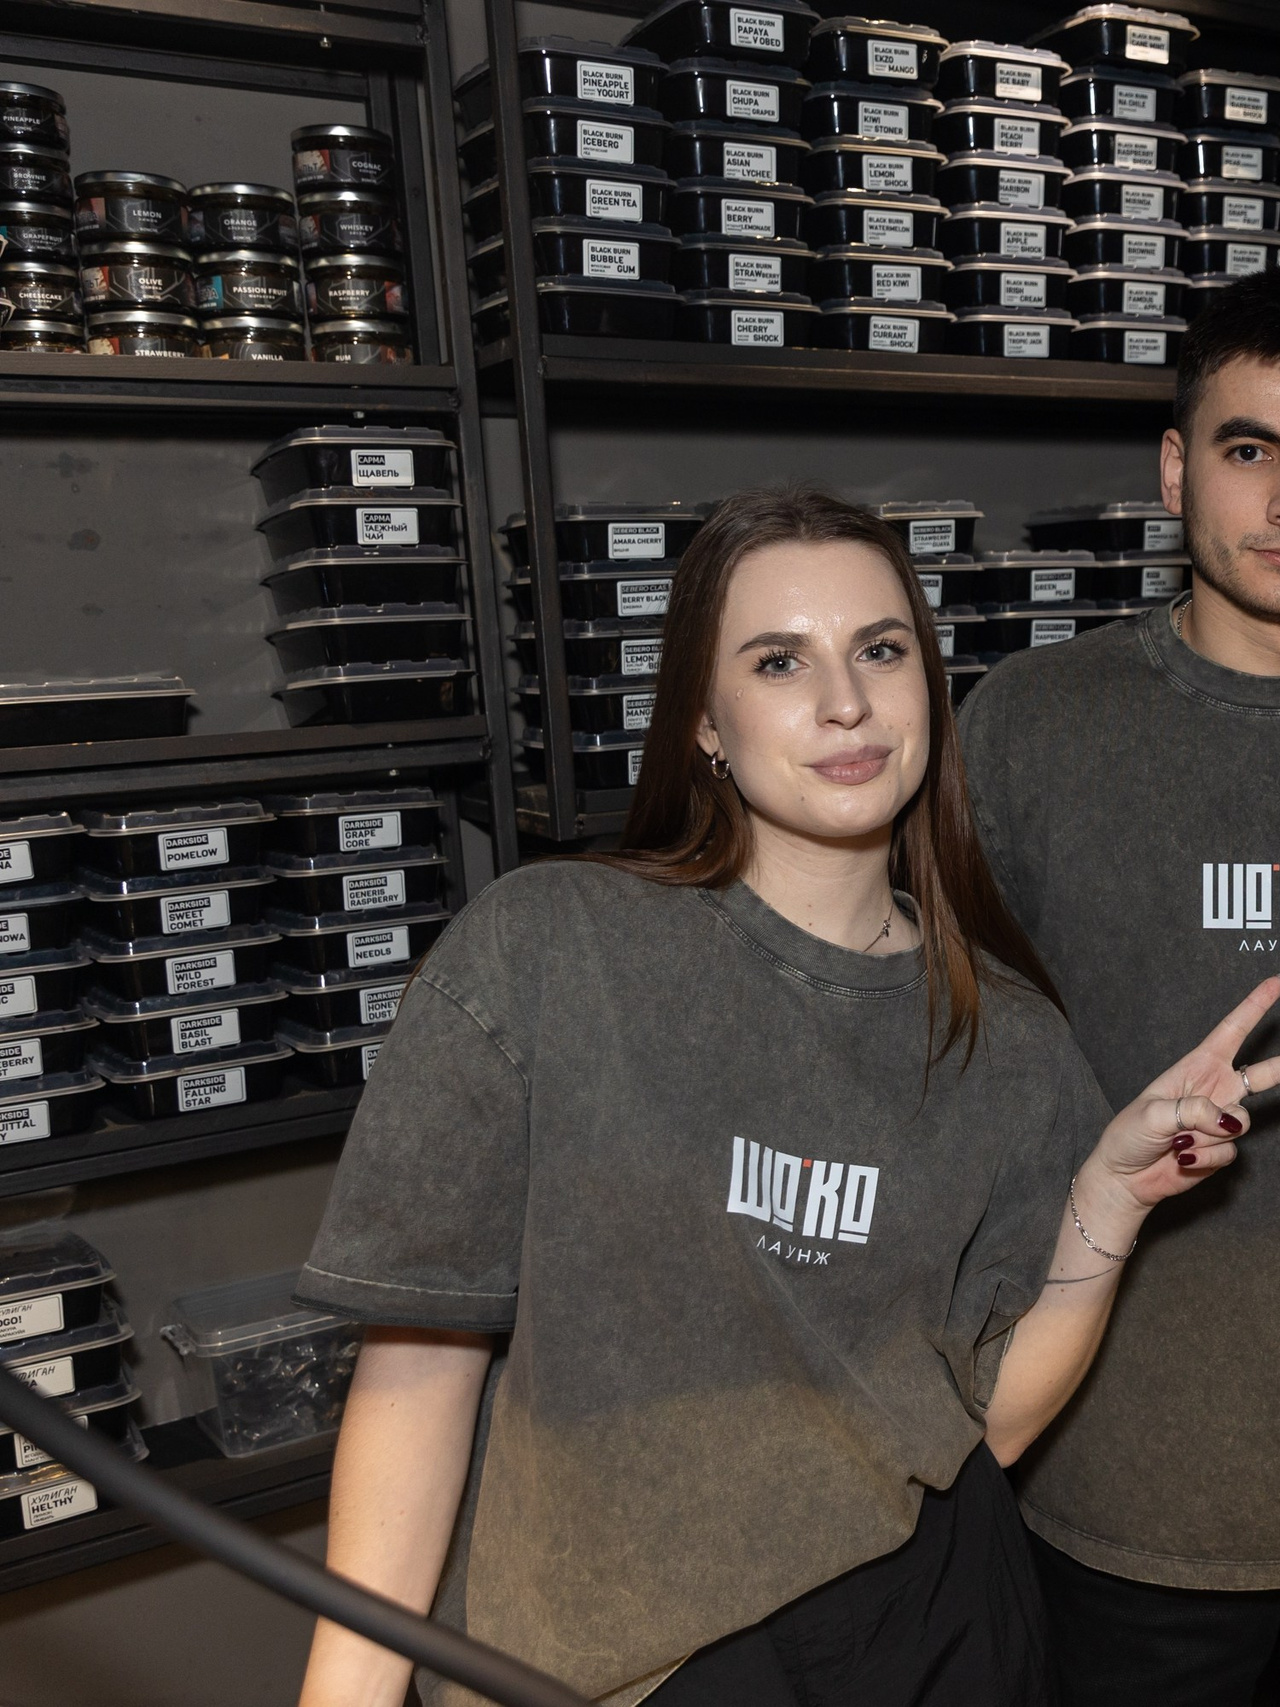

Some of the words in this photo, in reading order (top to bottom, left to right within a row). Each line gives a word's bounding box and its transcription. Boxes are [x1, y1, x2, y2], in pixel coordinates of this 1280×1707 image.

[737, 16, 756, 25] BLACK
[757, 19, 776, 27] BURN
[737, 26, 769, 37] PAPAYA
[753, 36, 760, 44] V
[760, 37, 781, 48] OBED
[874, 54, 894, 64] EKZO
[888, 65, 914, 74] MANGO
[583, 70, 602, 79] BLACK
[604, 72, 623, 80] BURN
[582, 78, 630, 90] PINEAPPLE
[1000, 77, 1012, 86] ICE
[1012, 78, 1030, 86] BABY
[597, 88, 630, 99] YOGURT
[732, 88, 750, 97] BLACK
[732, 96, 760, 106] CHUPA
[752, 108, 776, 117] GRAPER
[3, 115, 41, 125] PINEAPPLE
[864, 116, 881, 124] KIWI
[583, 129, 602, 138] BLACK
[604, 131, 623, 140] BURN
[874, 125, 904, 135] STONER
[1000, 132, 1023, 141] PEACH
[583, 138, 619, 149] ICEBERG
[1000, 140, 1023, 149] BERRY
[726, 150, 745, 158] BLACK
[746, 152, 764, 160] BURN
[352, 160, 382, 171] COGNAC
[726, 158, 750, 167] ASIAN
[14, 172, 46, 182] BROWNIE
[742, 169, 771, 178] LYCHEE
[869, 170, 895, 178] LEMON
[884, 179, 908, 188] SHOCK
[1000, 184, 1030, 194] HARIBON
[592, 196, 620, 206] GREEN
[621, 198, 638, 208] TEA
[132, 210, 162, 219] LEMON
[726, 214, 753, 223] BERRY
[223, 218, 257, 227] ORANGE
[340, 224, 374, 233] WHISKEY
[741, 224, 772, 232] LEMONADE
[868, 224, 910, 234] WATERMELON
[22, 232, 64, 244] GRAPEFRUIT
[1006, 236, 1028, 245] APPLE
[590, 246, 611, 254] BLACK
[1020, 246, 1043, 254] SHOCK
[1128, 246, 1156, 256] BROWNIE
[590, 254, 624, 264] BUBBLE
[617, 264, 636, 274] GUM
[734, 268, 780, 278] STRAWBERRY
[138, 277, 163, 286] OLIVE
[876, 279, 892, 288] RED
[892, 280, 910, 288] KIWI
[232, 286, 267, 295] PASSION
[268, 288, 288, 296] FRUIT
[328, 289, 370, 297] RASPBERRY
[1006, 286, 1024, 294] IRISH
[18, 292, 63, 302] CHEESECAKE
[1020, 295, 1043, 303] CREAM
[737, 324, 768, 334] CHERRY
[754, 334, 779, 342] SHOCK
[872, 330, 907, 340] CURRANT
[890, 340, 914, 348] SHOCK
[134, 349, 186, 358] STRAWBERRY
[252, 353, 284, 362] VANILLA
[335, 354, 352, 362] RUM
[358, 468, 400, 478] ЩАВЕЛЬ
[364, 522, 408, 532] ТАЕЖНЫЙ
[614, 527, 638, 535] SEBERO
[364, 532, 384, 541] ЧАЙ
[622, 585, 650, 593] SEBERO
[622, 595, 645, 604] BERRY
[646, 594, 668, 602] BLACK
[625, 646, 652, 654] SEBERO
[626, 655, 654, 664] LEMON
[344, 819, 382, 829] DARKSIDE
[345, 829, 376, 839] GRAPE
[166, 835, 208, 848] DARKSIDE
[346, 838, 370, 848] CORE
[168, 848, 218, 862] POMELOW
[349, 878, 387, 889] DARKSIDE
[350, 888, 385, 899] GENERIS
[168, 898, 210, 911] DARKSIDE
[350, 894, 399, 907] RASPBERRY
[169, 910, 204, 921] SWEET
[170, 919, 204, 930] COMET
[354, 932, 392, 945] DARKSIDE
[356, 946, 392, 960] NEEDLS
[175, 958, 216, 971] DARKSIDE
[176, 971, 202, 981] WILD
[176, 978, 215, 991] FOREST
[368, 1001, 398, 1012] HONEY
[368, 1010, 392, 1020] DUST
[180, 1017, 222, 1030] DARKSIDE
[181, 1029, 210, 1040] BASIL
[182, 1038, 212, 1049] BLAST
[184, 1075, 226, 1088] DARKSIDE
[184, 1084, 226, 1098] FALLING
[185, 1096, 212, 1106] STAR
[0, 1110, 28, 1120] KSIDE
[726, 1136, 880, 1244] ШОКО
[756, 1234, 831, 1265] ЛАУНЖ
[31, 1485, 78, 1506] ХУЛИГАН
[32, 1496, 74, 1514] HELTHY
